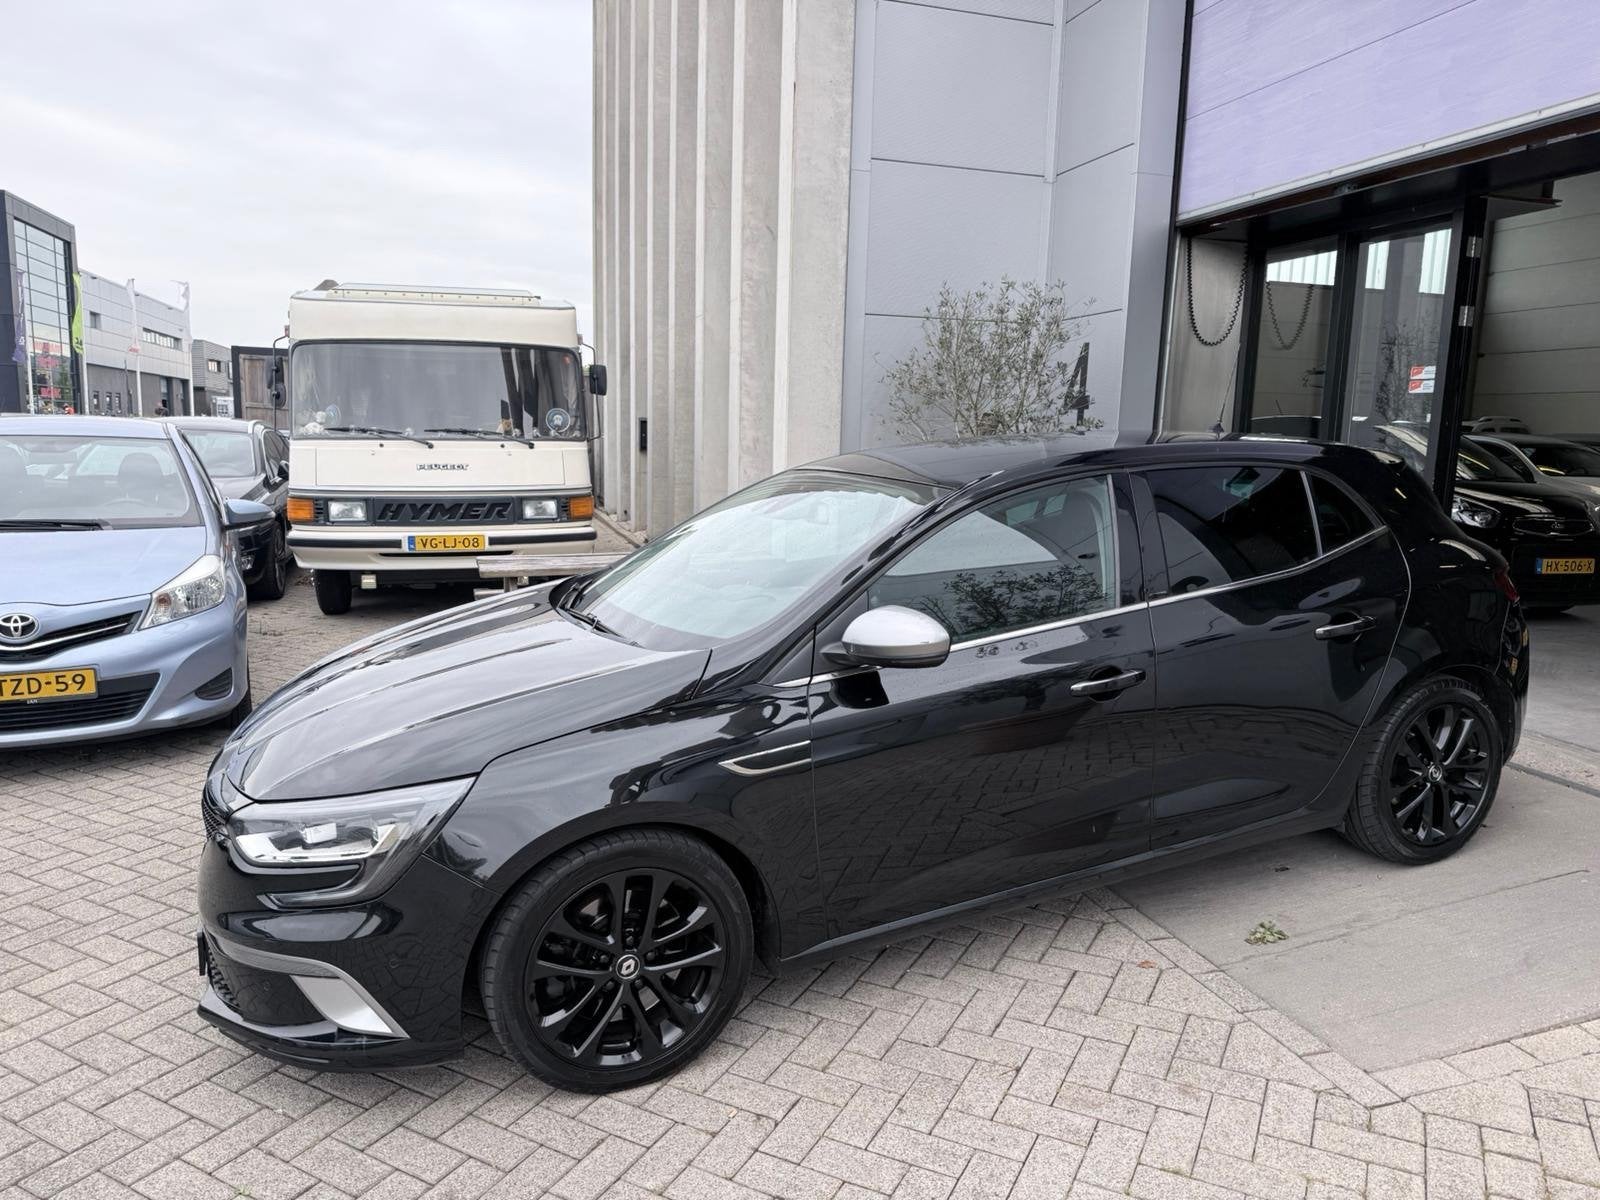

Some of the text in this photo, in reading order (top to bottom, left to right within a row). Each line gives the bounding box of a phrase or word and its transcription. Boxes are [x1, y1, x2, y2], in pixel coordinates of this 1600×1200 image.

[1063, 342, 1091, 426] 4
[377, 503, 513, 521] HYMER
[420, 537, 480, 549] VG-LJ-08
[1545, 560, 1593, 572] HX-506-X
